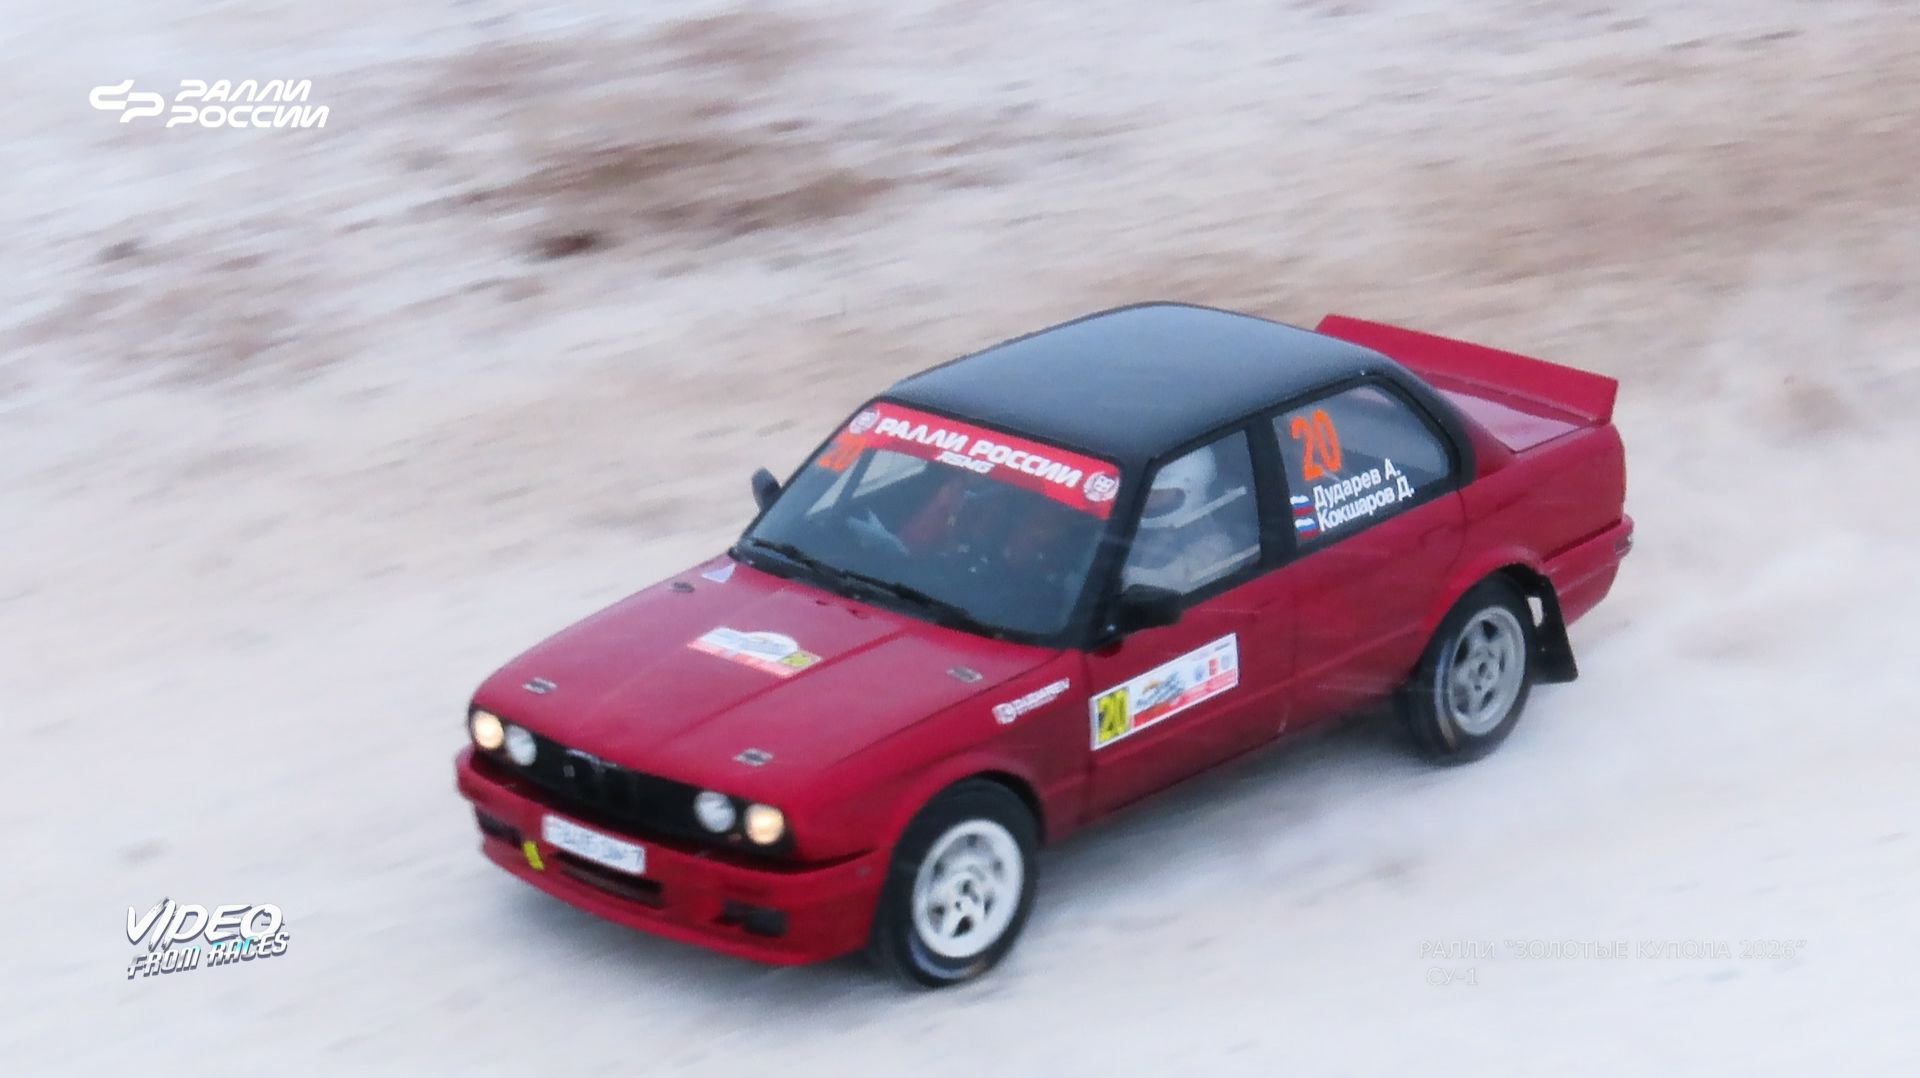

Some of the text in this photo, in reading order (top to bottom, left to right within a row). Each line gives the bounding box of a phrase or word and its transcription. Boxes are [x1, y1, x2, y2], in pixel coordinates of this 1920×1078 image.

[875, 417, 1083, 488] РАЛЛИ РОССИИ
[1290, 409, 1341, 481] 20
[1313, 457, 1402, 509] Дударев А.
[1316, 475, 1416, 532] Кокшаров Д.
[1098, 688, 1129, 743] 20
